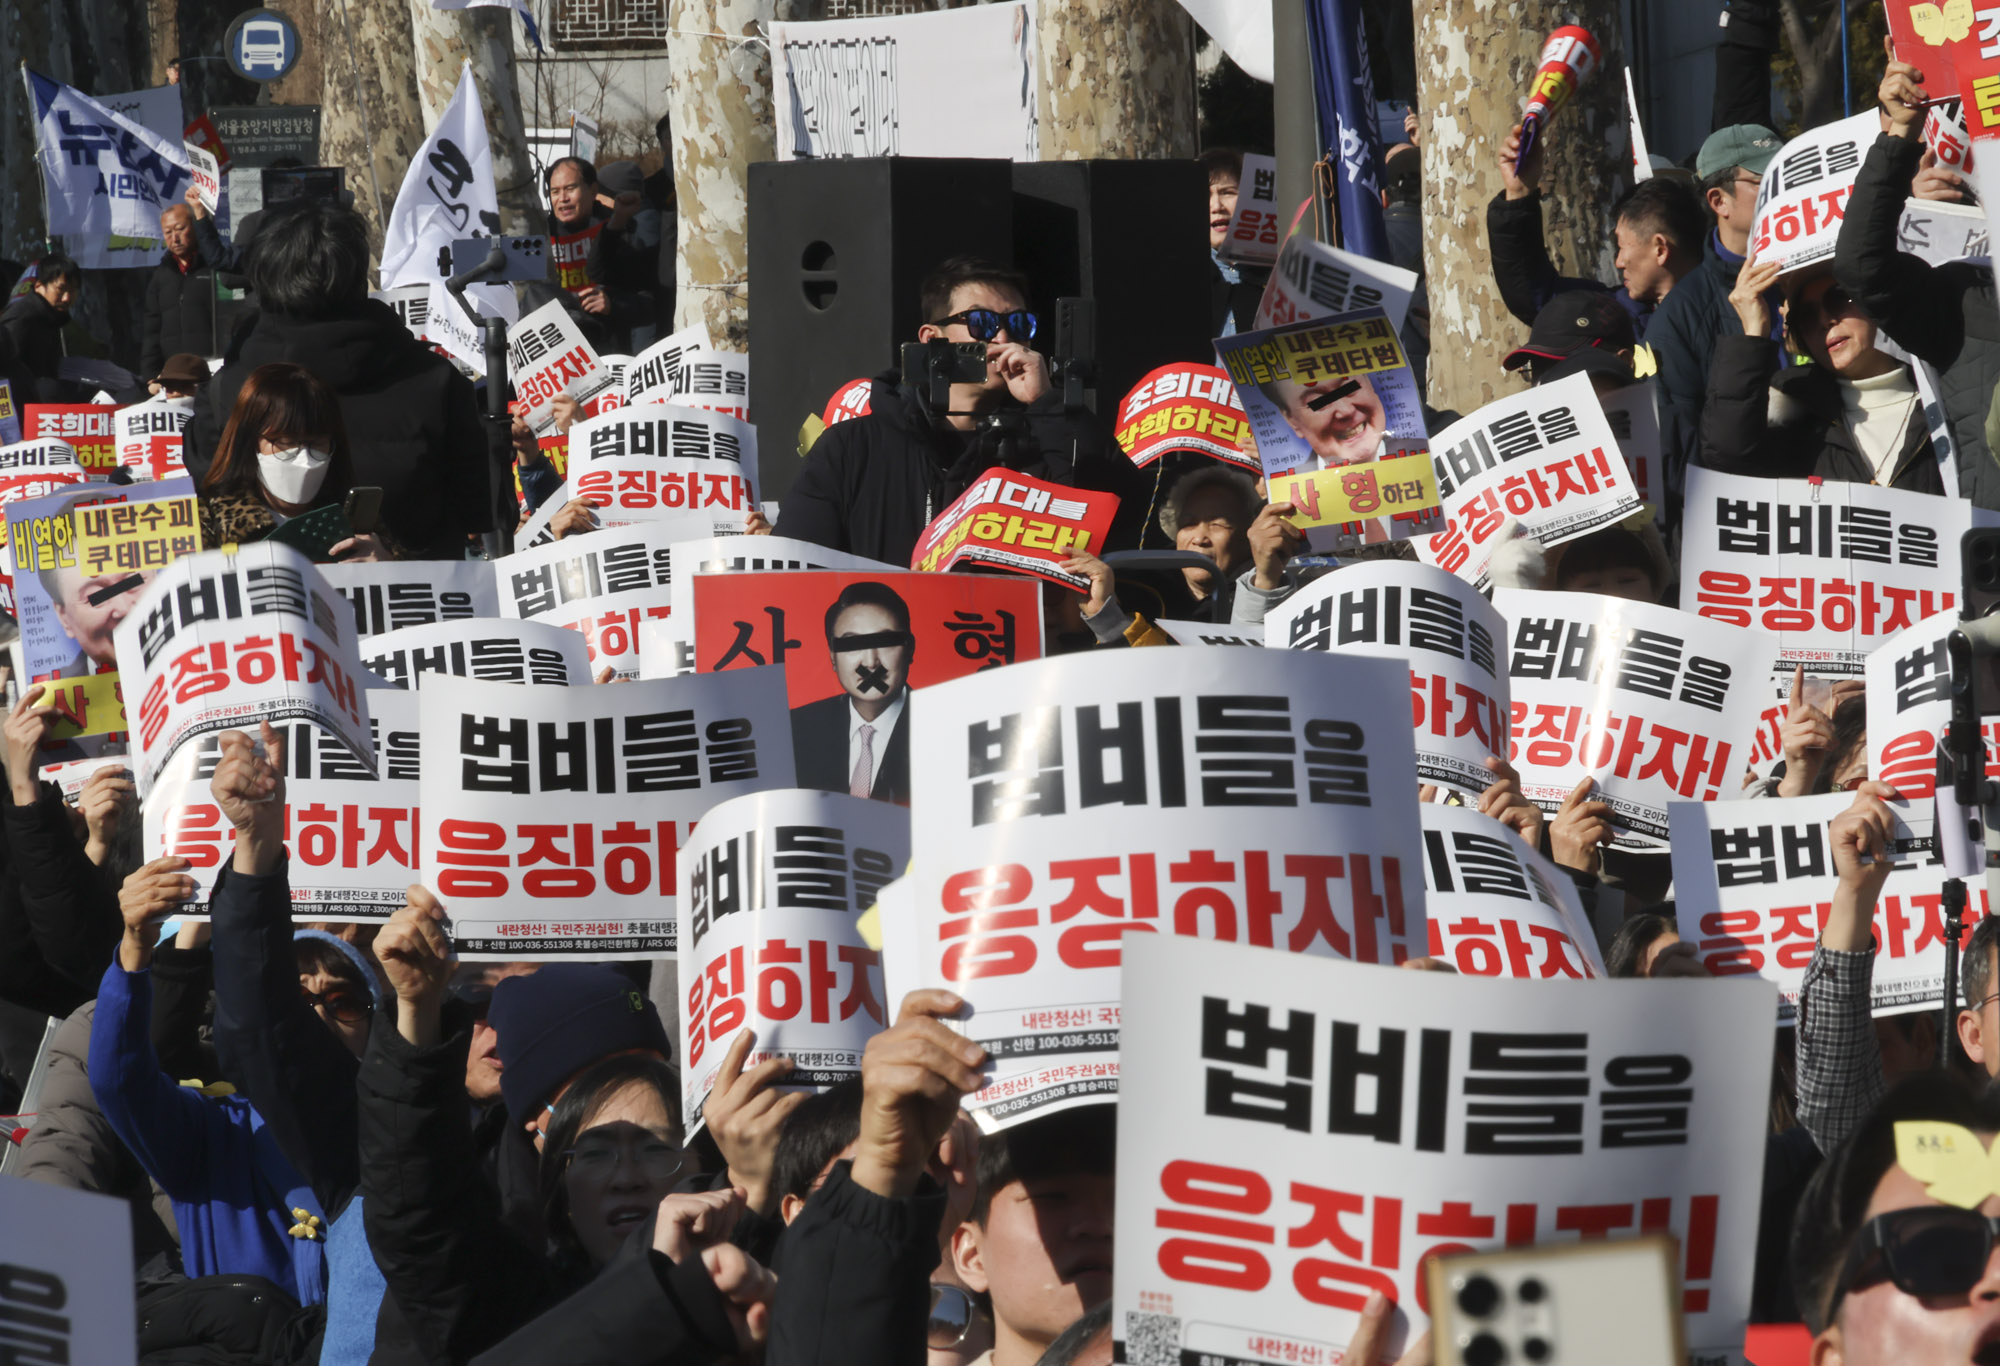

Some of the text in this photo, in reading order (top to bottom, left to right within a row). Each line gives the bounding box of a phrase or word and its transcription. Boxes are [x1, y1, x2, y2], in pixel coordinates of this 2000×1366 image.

[218, 117, 313, 136] 서울중앙지방검찰청
[1252, 168, 1277, 202] 법
[1284, 318, 1390, 353] 내란수괴
[630, 344, 701, 400] 법비들
[1223, 335, 1292, 387] 비열한
[1294, 342, 1400, 381] 쿠데타범
[590, 419, 741, 463] 법비들을
[1116, 404, 1254, 454] 탄핵하라
[577, 469, 755, 512] 응징하자!
[926, 477, 1088, 550] 조희대를
[1287, 478, 1321, 521] 사
[1429, 446, 1617, 574] 응징하자!
[83, 498, 195, 538] 내란수괴
[921, 511, 1092, 572] 탄핵하라!
[1716, 496, 1939, 568] 법비들을
[11, 512, 77, 574] 비열한
[86, 532, 197, 573] 쿠데타범
[511, 543, 671, 620] 법비들을
[138, 566, 339, 673] 법비들을
[713, 605, 802, 672] 사
[1288, 585, 1497, 680] 법비들을
[361, 638, 570, 690] 법비들을
[1510, 617, 1732, 713] 법비들을
[1780, 650, 1834, 660] 국민주권실현!
[1798, 662, 1845, 671] 불승리전환행동
[1894, 637, 1953, 715] 법
[49, 684, 90, 729] 사
[139, 632, 361, 753] 응징하자!
[195, 704, 255, 722] 국민주권실현!
[275, 710, 290, 718] ARS
[460, 709, 759, 794] 법비들을
[967, 695, 1372, 827] 법비들을
[1418, 766, 1432, 775] ARS
[1467, 766, 1494, 781] 모이자!
[1510, 699, 1732, 801] 응징하자!
[160, 802, 420, 870] 응하자
[436, 818, 698, 898] 응징하
[691, 825, 895, 949] 법비들을
[1423, 830, 1560, 911] 들을
[314, 890, 379, 901] 촛불대행진으로
[329, 904, 343, 912] ARS
[939, 849, 1409, 983] 응징하자!
[467, 940, 483, 950] 후원
[490, 940, 505, 950] 신한
[508, 940, 573, 950] 100-036-551308
[574, 938, 640, 950] 촛불승리전환행동
[647, 938, 663, 948] ARS
[497, 923, 547, 936] 내란청산!
[550, 922, 624, 936] 국민주권실현!
[1022, 1010, 1092, 1030] 내란청산!
[1012, 1037, 1035, 1051] 신한
[975, 1062, 1121, 1102] 내란청산! 국민주권실현
[991, 1080, 1118, 1117] 100-036-551308 촛불승리전
[1201, 995, 1694, 1155] 법비들을
[1248, 1335, 1345, 1365] 내란청산! 국
